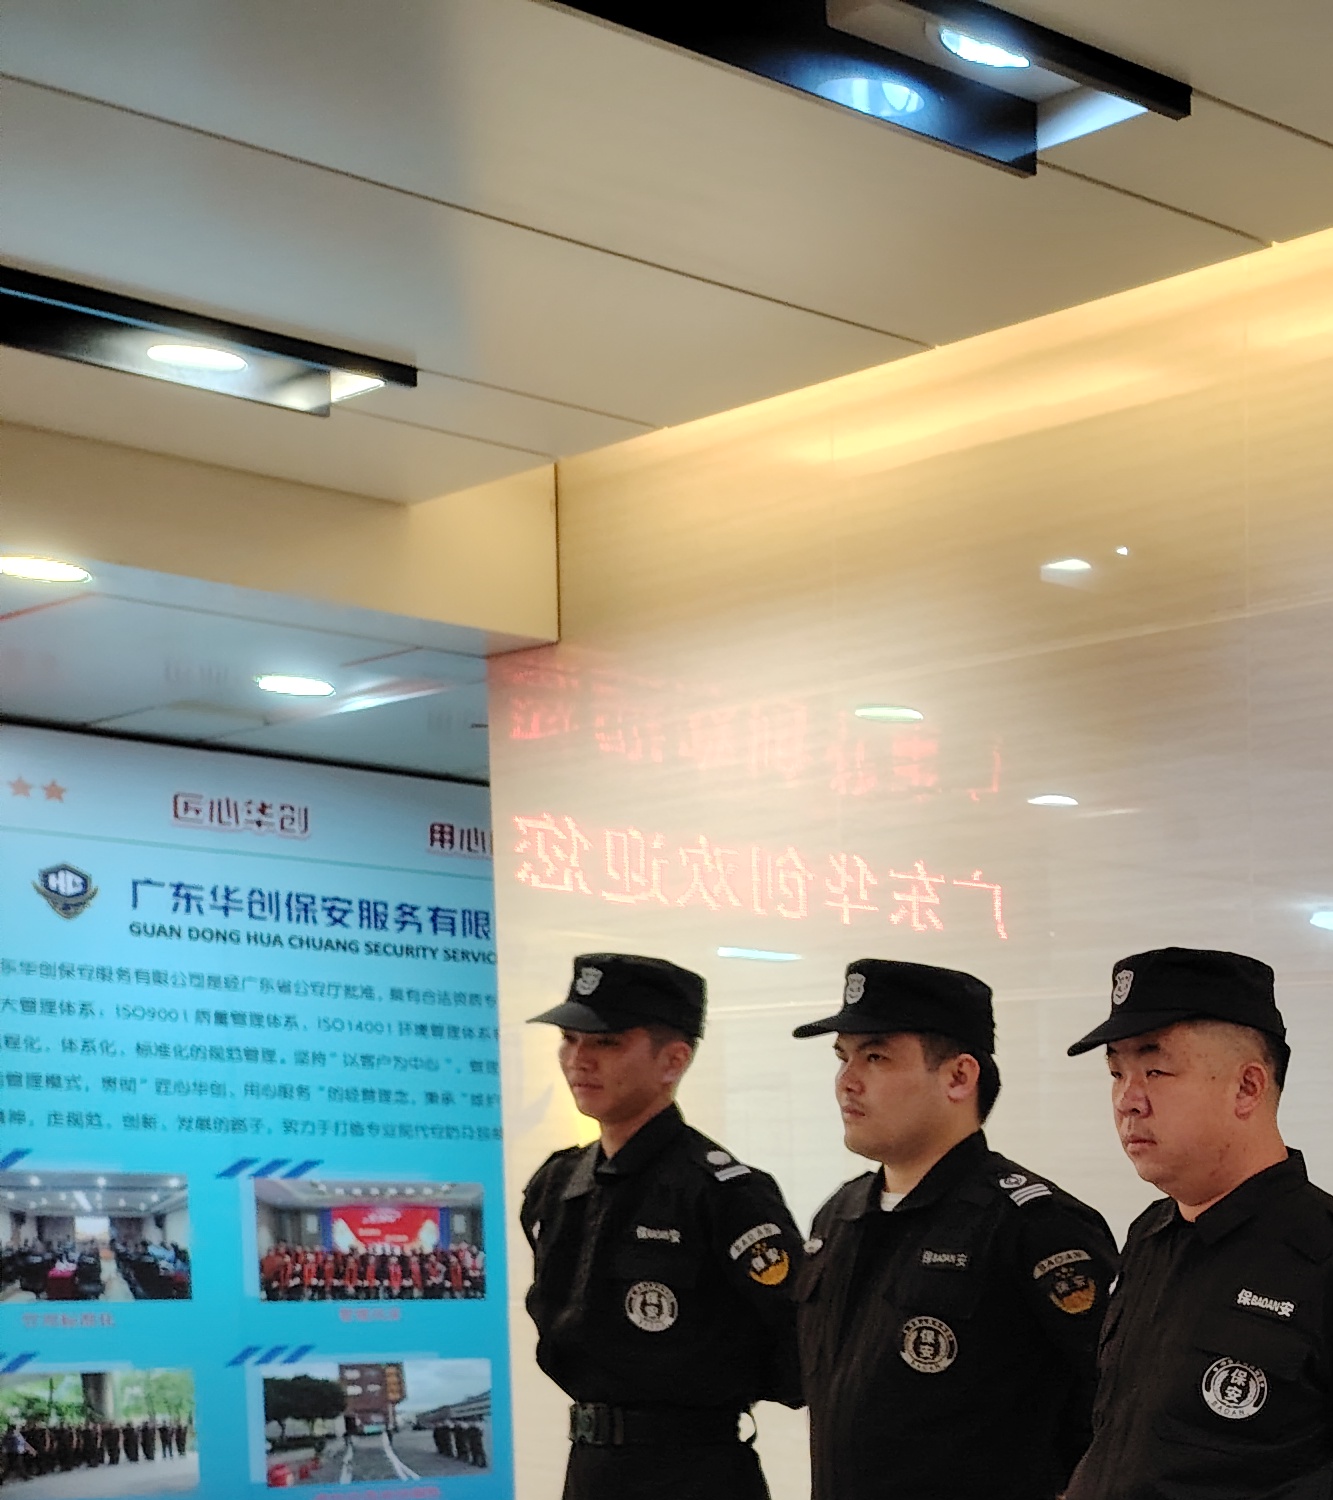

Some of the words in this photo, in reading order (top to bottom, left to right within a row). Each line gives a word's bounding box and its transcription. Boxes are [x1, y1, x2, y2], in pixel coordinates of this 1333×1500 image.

[172, 792, 309, 835] 匠心华创
[429, 822, 493, 853] 用心
[131, 877, 491, 941] 广东华创保安服务有限
[129, 921, 181, 940] GUAN
[187, 925, 241, 944] DONG
[246, 930, 284, 948] HUA
[288, 934, 360, 955] CHUANG
[364, 940, 439, 960] SECURITY
[1039, 1250, 1082, 1272] BAOAN
[1224, 1368, 1247, 1404] 保安
